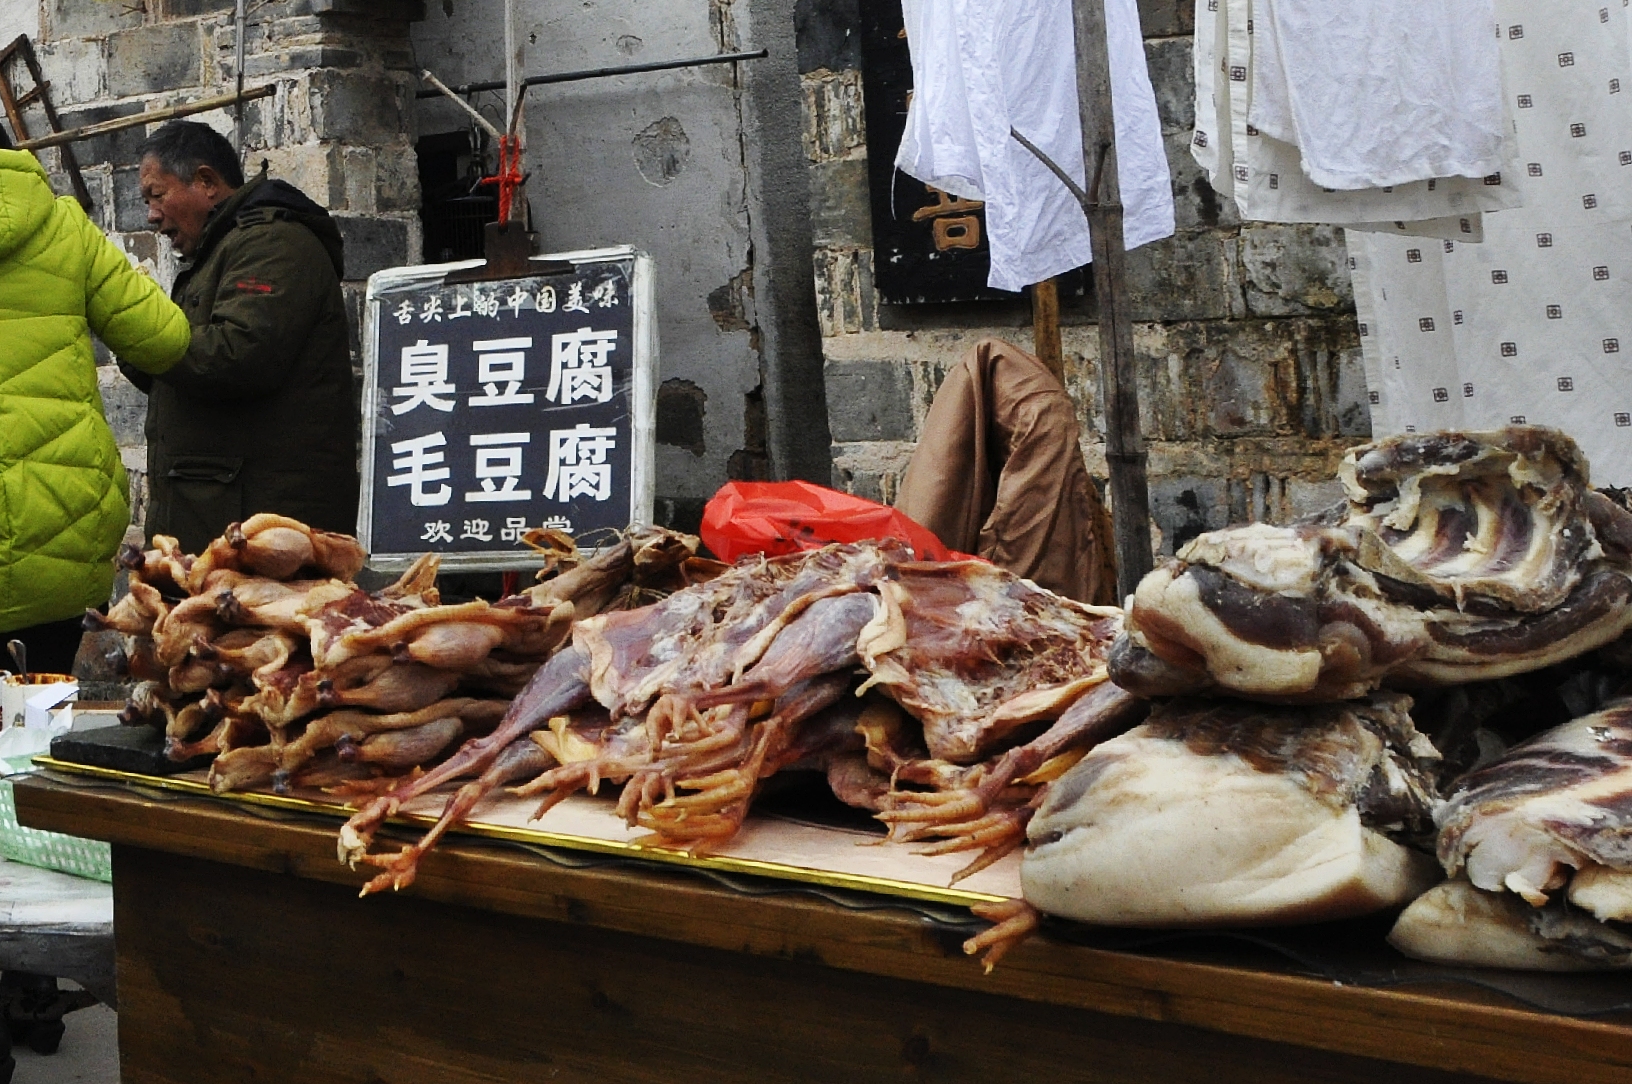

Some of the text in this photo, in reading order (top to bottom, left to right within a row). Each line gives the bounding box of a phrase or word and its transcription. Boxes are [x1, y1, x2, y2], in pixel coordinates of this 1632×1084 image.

[393, 280, 619, 325] 舌尖上的中国美味
[390, 327, 618, 416] 臭豆腐
[386, 424, 617, 507] 毛豆腐
[419, 516, 575, 543] 欢迎品尝
